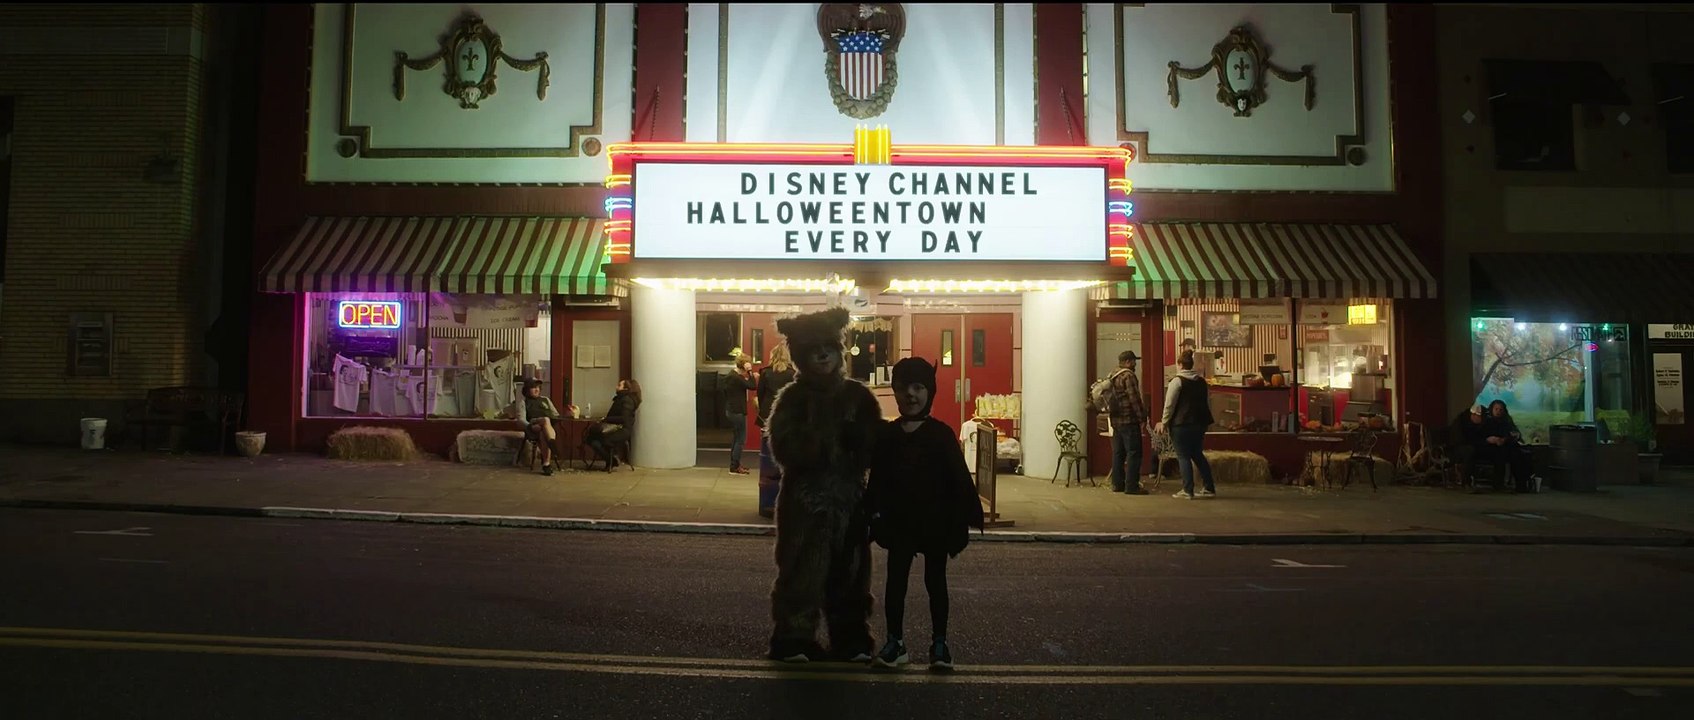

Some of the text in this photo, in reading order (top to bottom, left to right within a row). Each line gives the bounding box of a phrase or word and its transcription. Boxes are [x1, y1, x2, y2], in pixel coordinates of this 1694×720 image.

[741, 172, 1037, 195] DISNEY CHANNEL
[687, 202, 985, 225] HALLOWEENTOWN
[785, 230, 982, 253] EVERY DAY
[341, 304, 398, 325] OPEN
